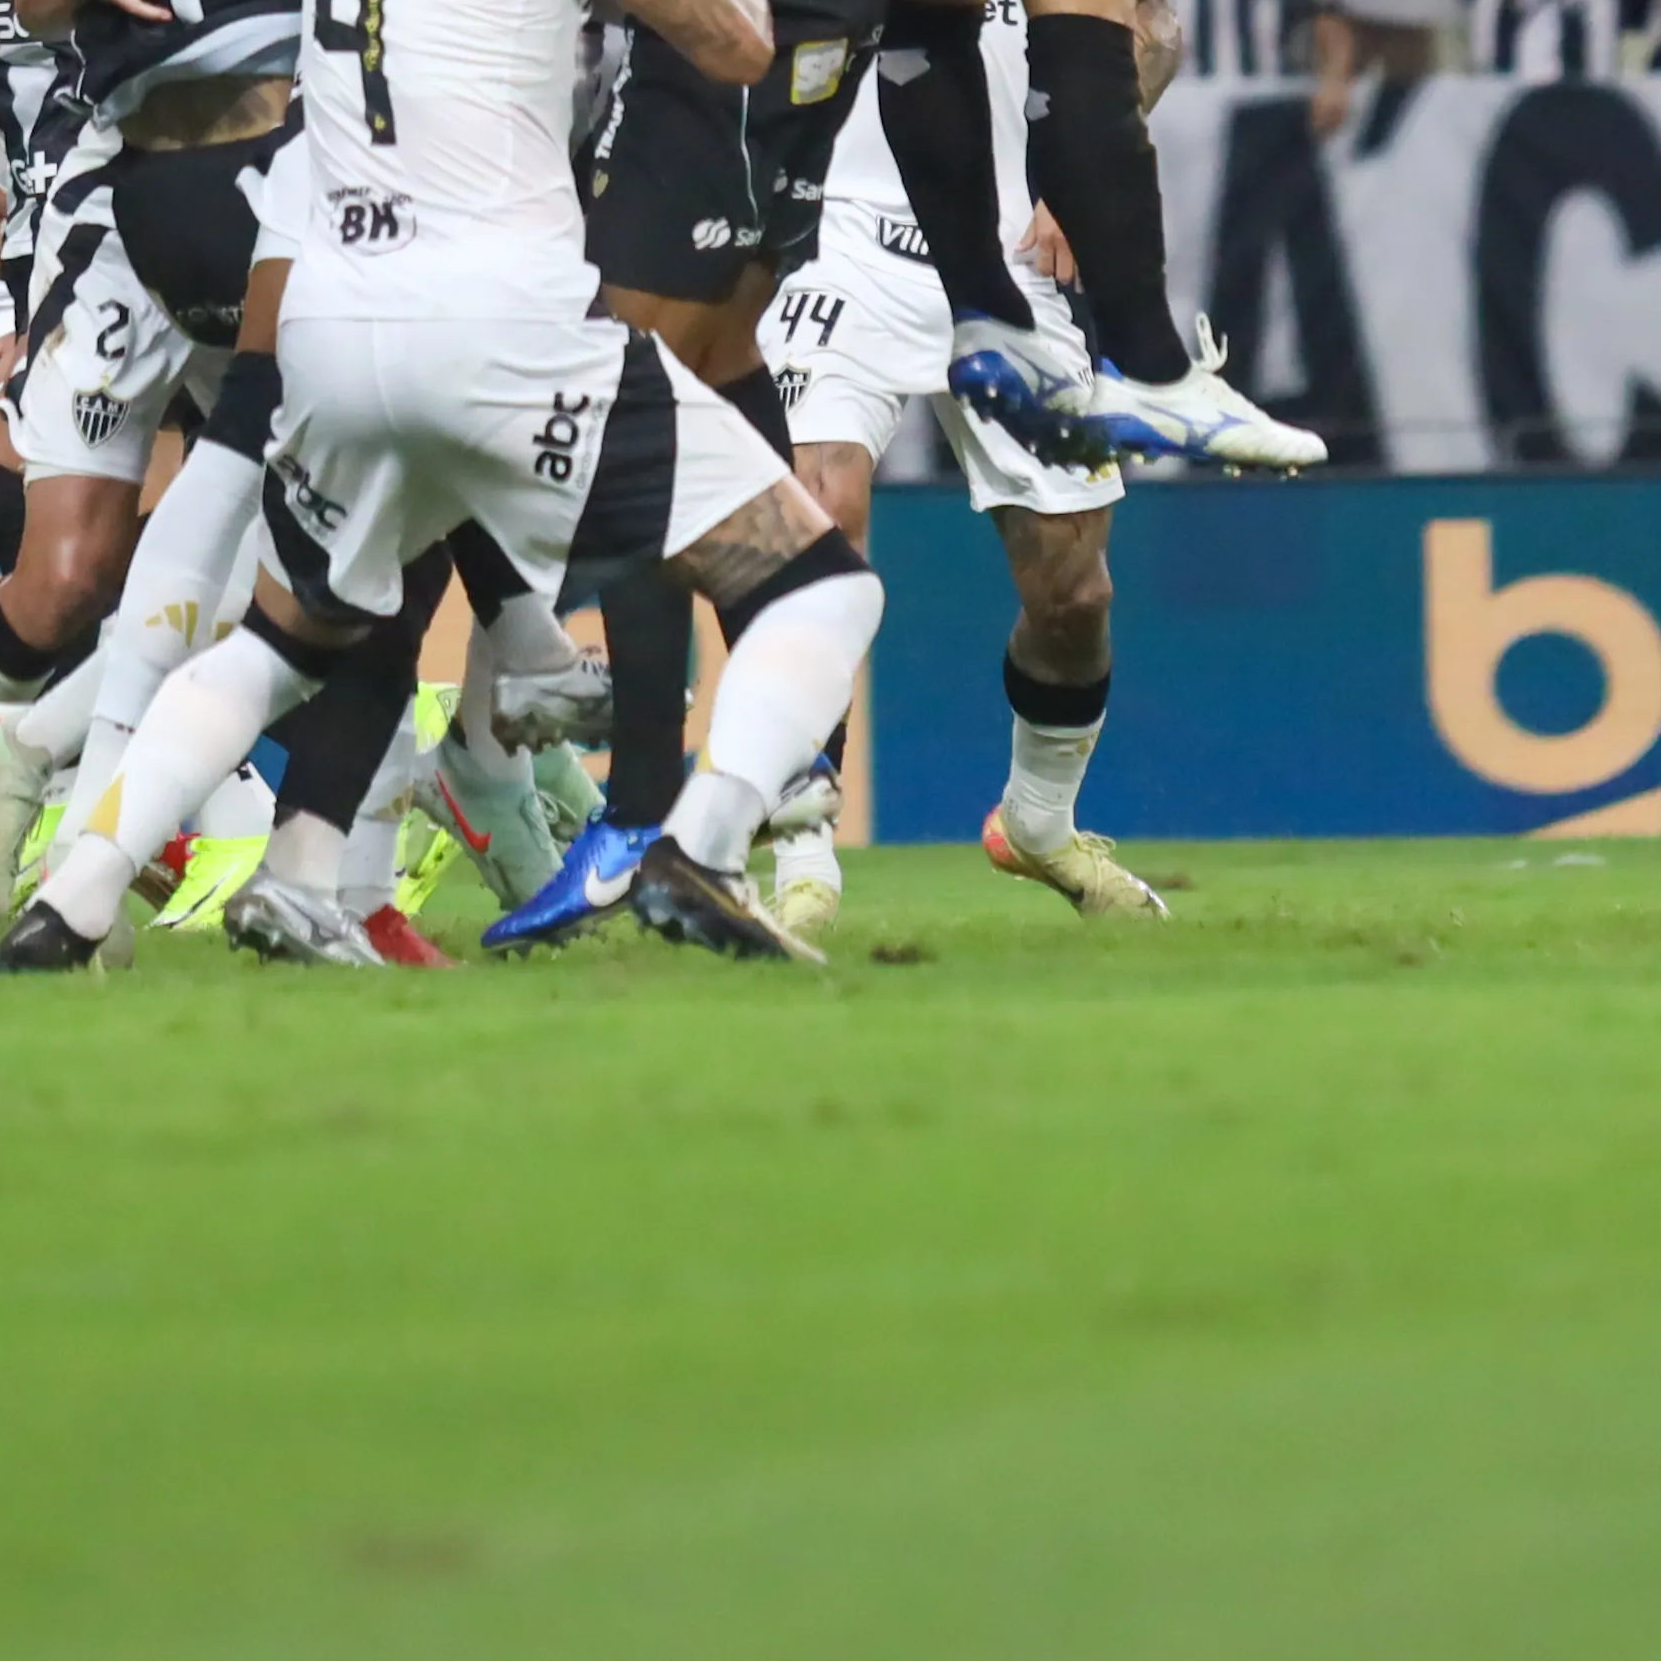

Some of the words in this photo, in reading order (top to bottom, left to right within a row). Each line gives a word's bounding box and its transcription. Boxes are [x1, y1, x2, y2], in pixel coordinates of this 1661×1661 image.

[340, 201, 399, 245] BH
[96, 299, 133, 360] 2
[779, 293, 846, 347] 44
[79, 395, 122, 415] CAM
[533, 391, 591, 483] abc
